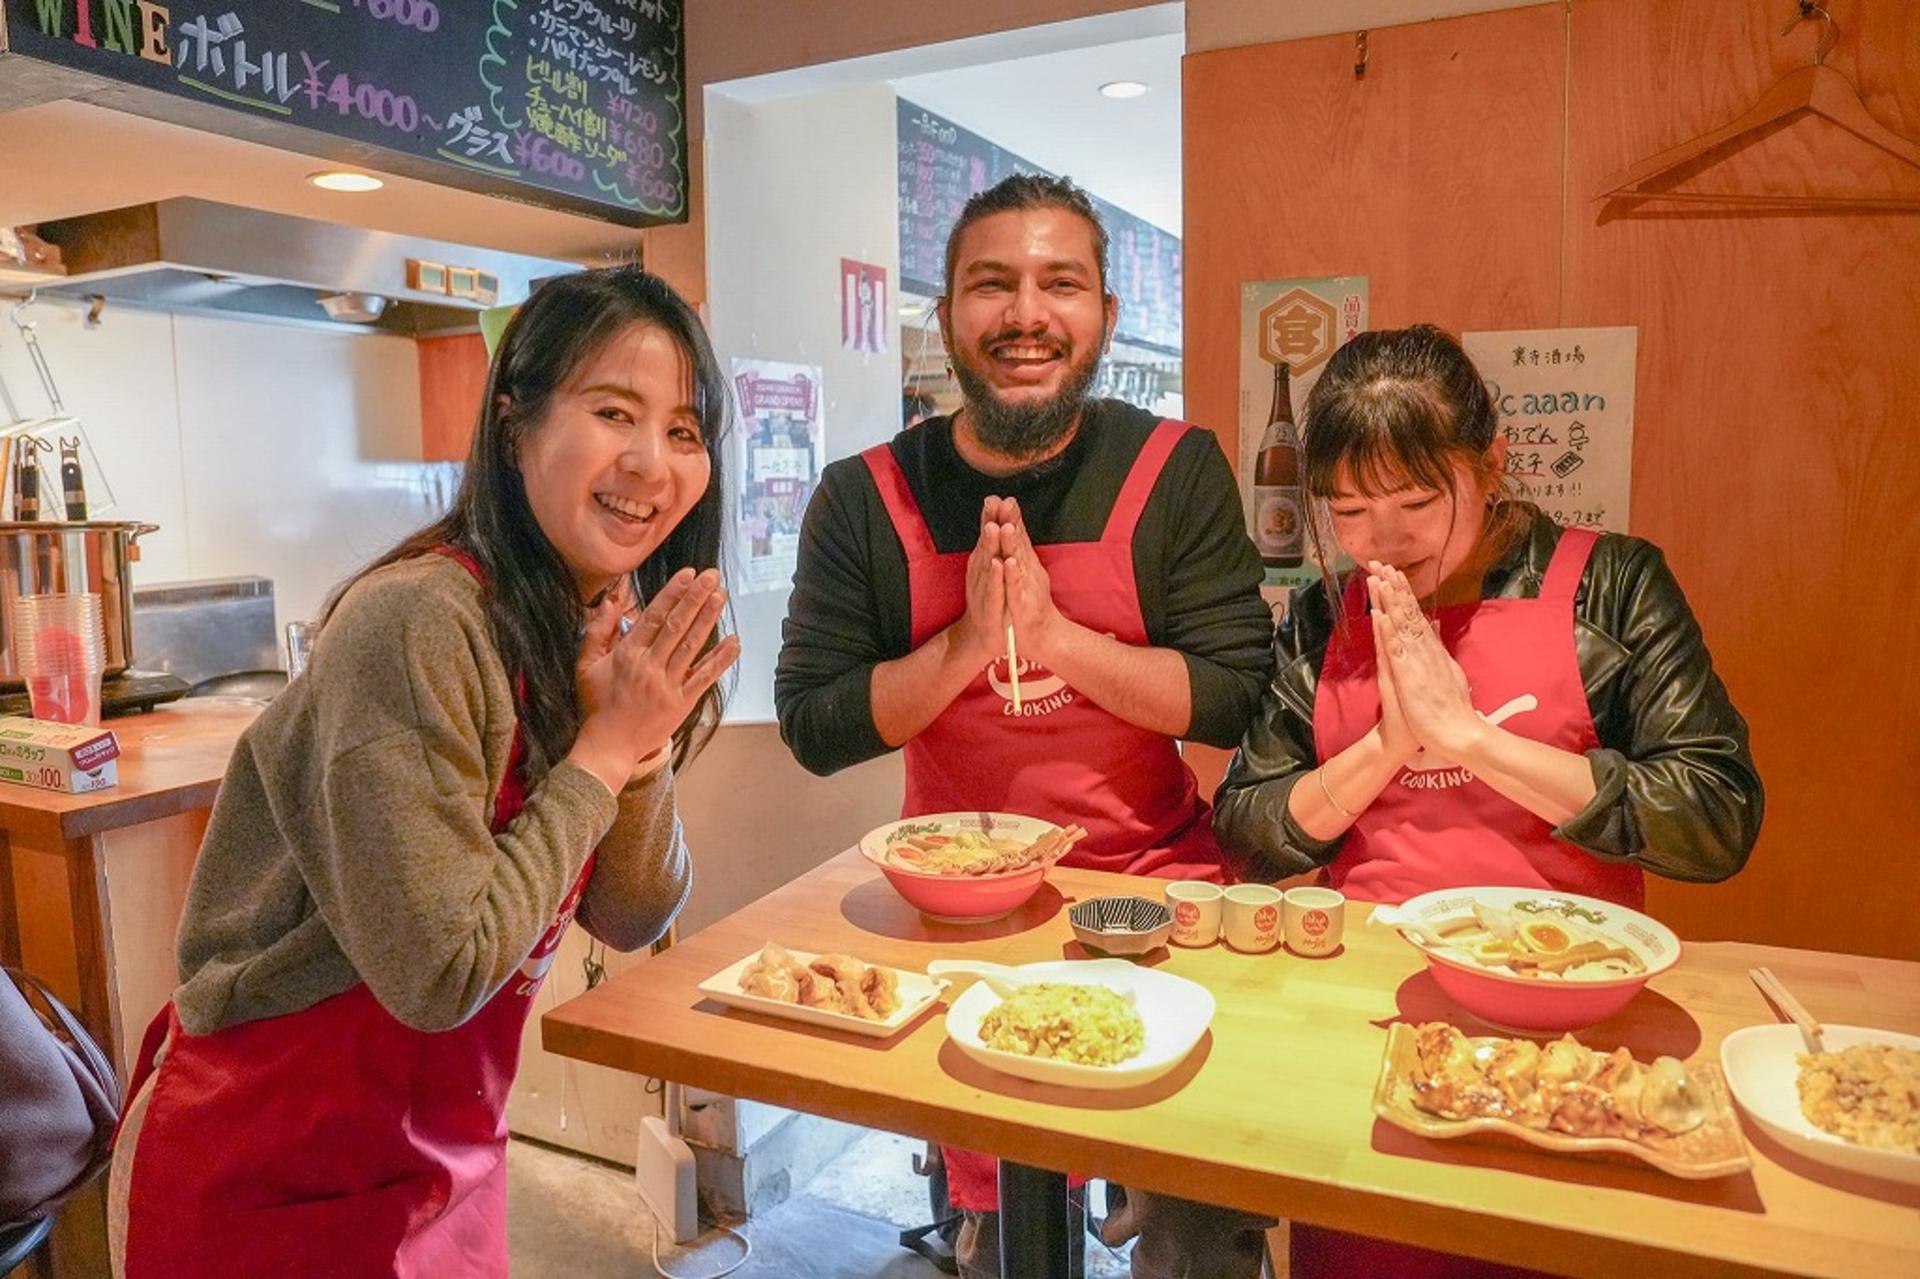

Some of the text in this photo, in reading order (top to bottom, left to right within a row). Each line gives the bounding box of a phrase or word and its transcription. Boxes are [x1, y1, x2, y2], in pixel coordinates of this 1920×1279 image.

[36, 0, 172, 65] WINE
[177, 12, 300, 104] ボトル
[446, 105, 514, 164] グラス
[514, 129, 585, 181] ¥600
[1503, 422, 1558, 444] おでん
[1400, 767, 1473, 790] COOKING
